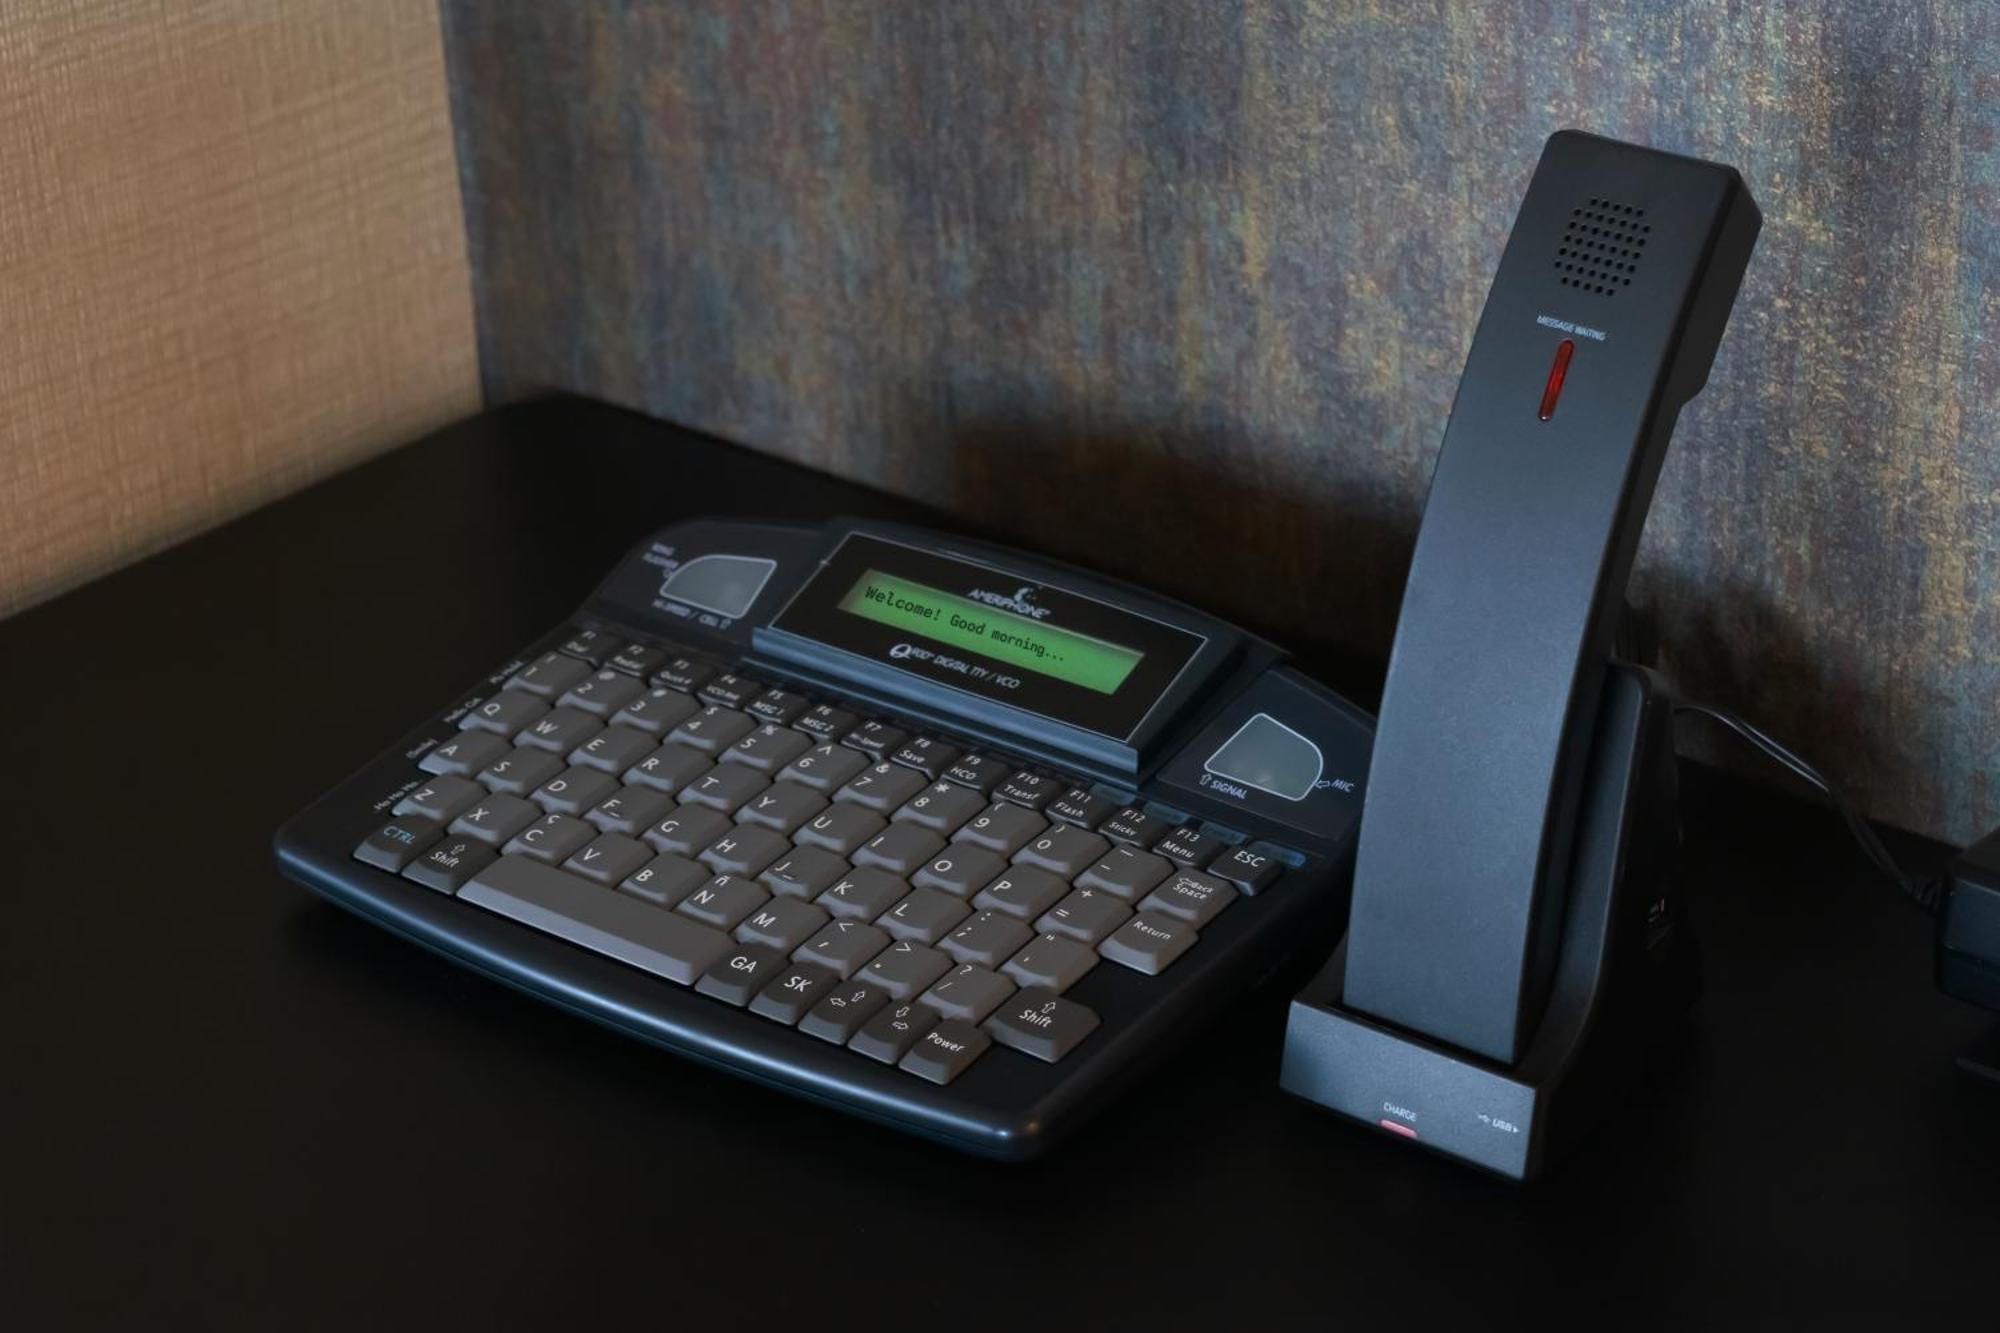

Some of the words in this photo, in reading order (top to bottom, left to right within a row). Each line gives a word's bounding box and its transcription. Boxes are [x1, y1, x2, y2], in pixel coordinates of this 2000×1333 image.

[864, 586, 942, 621] Welcome!
[949, 614, 987, 635] Good
[991, 629, 1064, 662] morning...
[576, 681, 595, 696] 2
[996, 675, 1021, 689] VCO
[482, 702, 501, 716] Q
[629, 700, 648, 712] 3
[815, 705, 833, 716] F6
[535, 719, 560, 735] W
[686, 719, 702, 731] 4
[863, 721, 883, 732] F7
[585, 738, 606, 752] E
[739, 737, 758, 750] 5
[913, 737, 933, 749] F8
[440, 745, 459, 758] A
[899, 749, 926, 764] Save
[493, 760, 512, 774] S
[641, 757, 660, 771] R
[798, 756, 817, 768] 6
[965, 754, 982, 766] F9
[950, 766, 978, 780] HCO
[1016, 771, 1041, 785] F10
[547, 780, 568, 793] D
[701, 775, 721, 789] T
[854, 775, 874, 787] 7
[1331, 779, 1356, 793] MIC
[413, 787, 437, 801] Z
[1068, 789, 1093, 803] F11
[1209, 779, 1249, 800] SIGNAL
[757, 796, 778, 809] Y
[913, 796, 932, 808] 8
[467, 806, 491, 822] X
[1054, 801, 1085, 818] Flash
[1121, 809, 1147, 823] F12
[660, 819, 681, 833] G
[811, 815, 834, 830] U
[972, 816, 992, 829] 9
[1108, 820, 1139, 837] Sticky
[382, 824, 418, 846] CTRL
[524, 829, 545, 842] C
[1176, 827, 1201, 842] F13
[715, 839, 737, 854] H
[1160, 840, 1196, 859] Menu
[430, 849, 461, 868] Shift
[582, 847, 602, 861] V
[1232, 849, 1267, 868] ESC
[634, 868, 655, 883] B
[832, 881, 855, 896] K
[991, 879, 1014, 893] P
[1171, 883, 1209, 900] Space
[692, 888, 717, 904] N
[894, 902, 910, 917] L
[751, 911, 778, 928] M
[1133, 920, 1173, 941] Return
[729, 955, 758, 974] GA
[783, 975, 813, 993] SK
[1018, 1008, 1054, 1029] Shift
[926, 1031, 967, 1053] Power
[1383, 1102, 1418, 1123] CHARGE
[1492, 1118, 1513, 1133] USB
